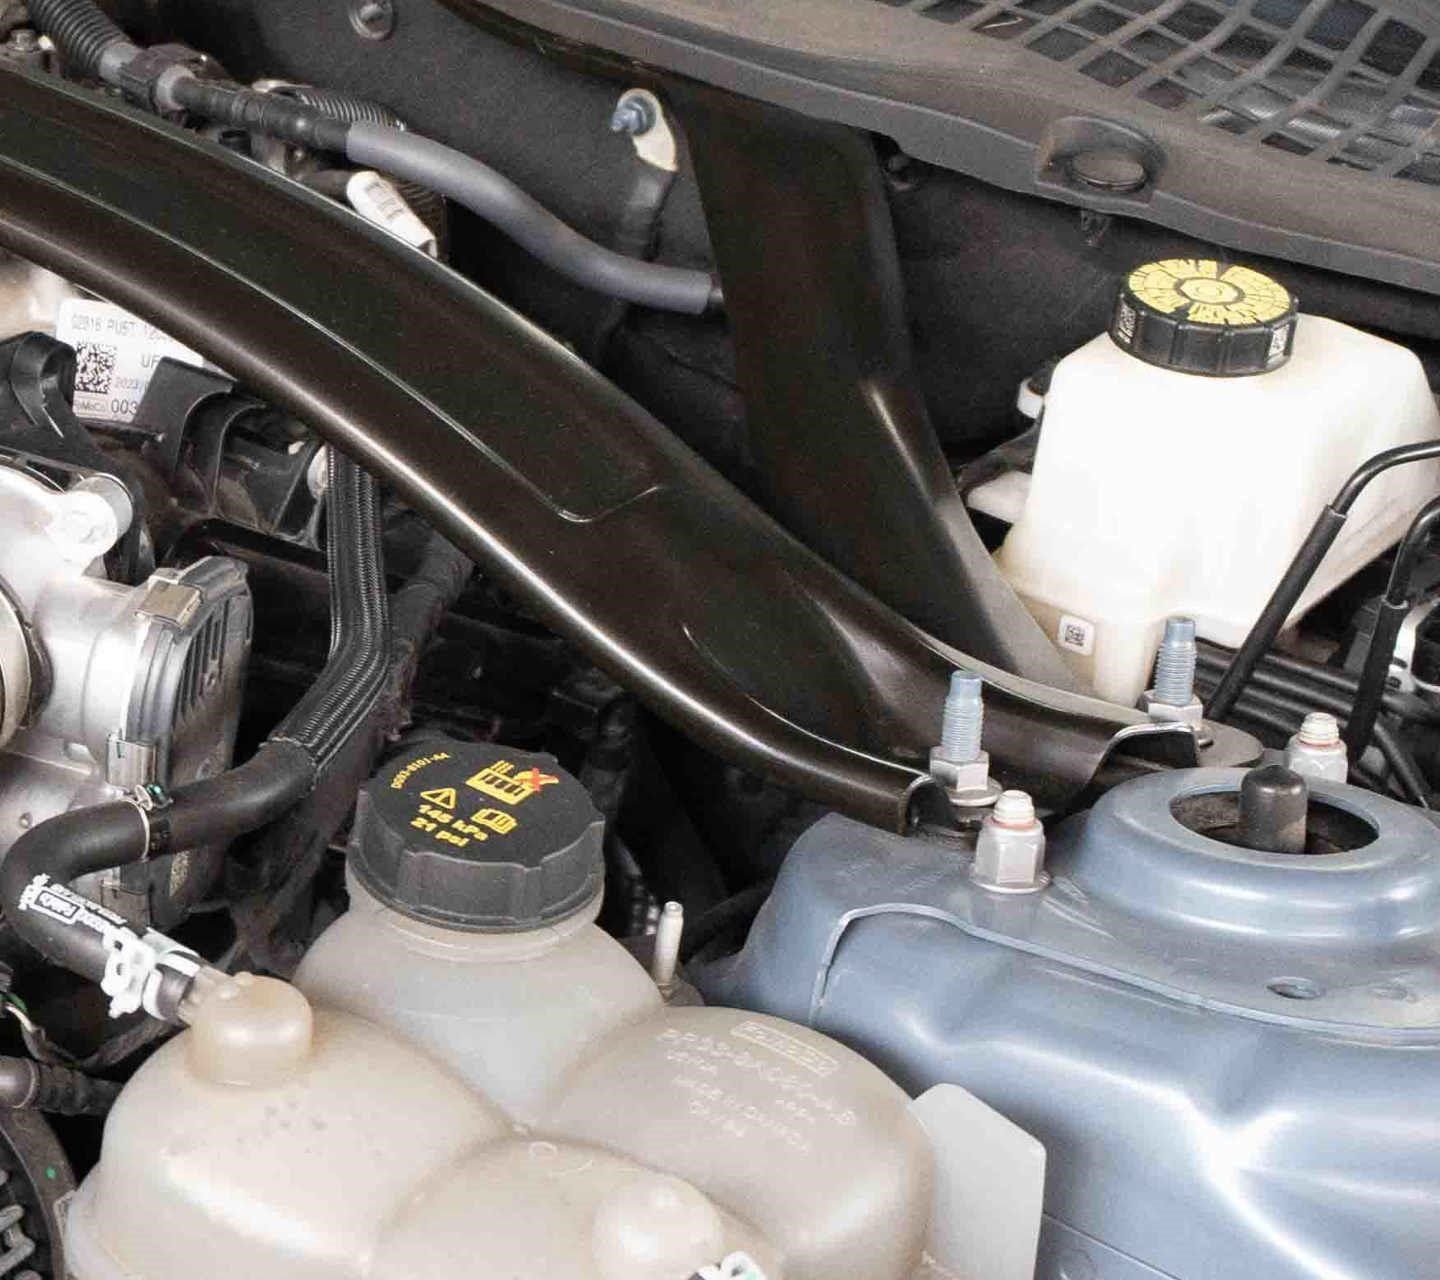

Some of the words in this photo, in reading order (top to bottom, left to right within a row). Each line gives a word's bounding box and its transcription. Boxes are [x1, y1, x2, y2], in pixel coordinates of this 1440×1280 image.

[410, 817, 438, 833] 21
[435, 830, 470, 848] psi
[418, 803, 454, 824] 145
[451, 819, 489, 842] kPa
